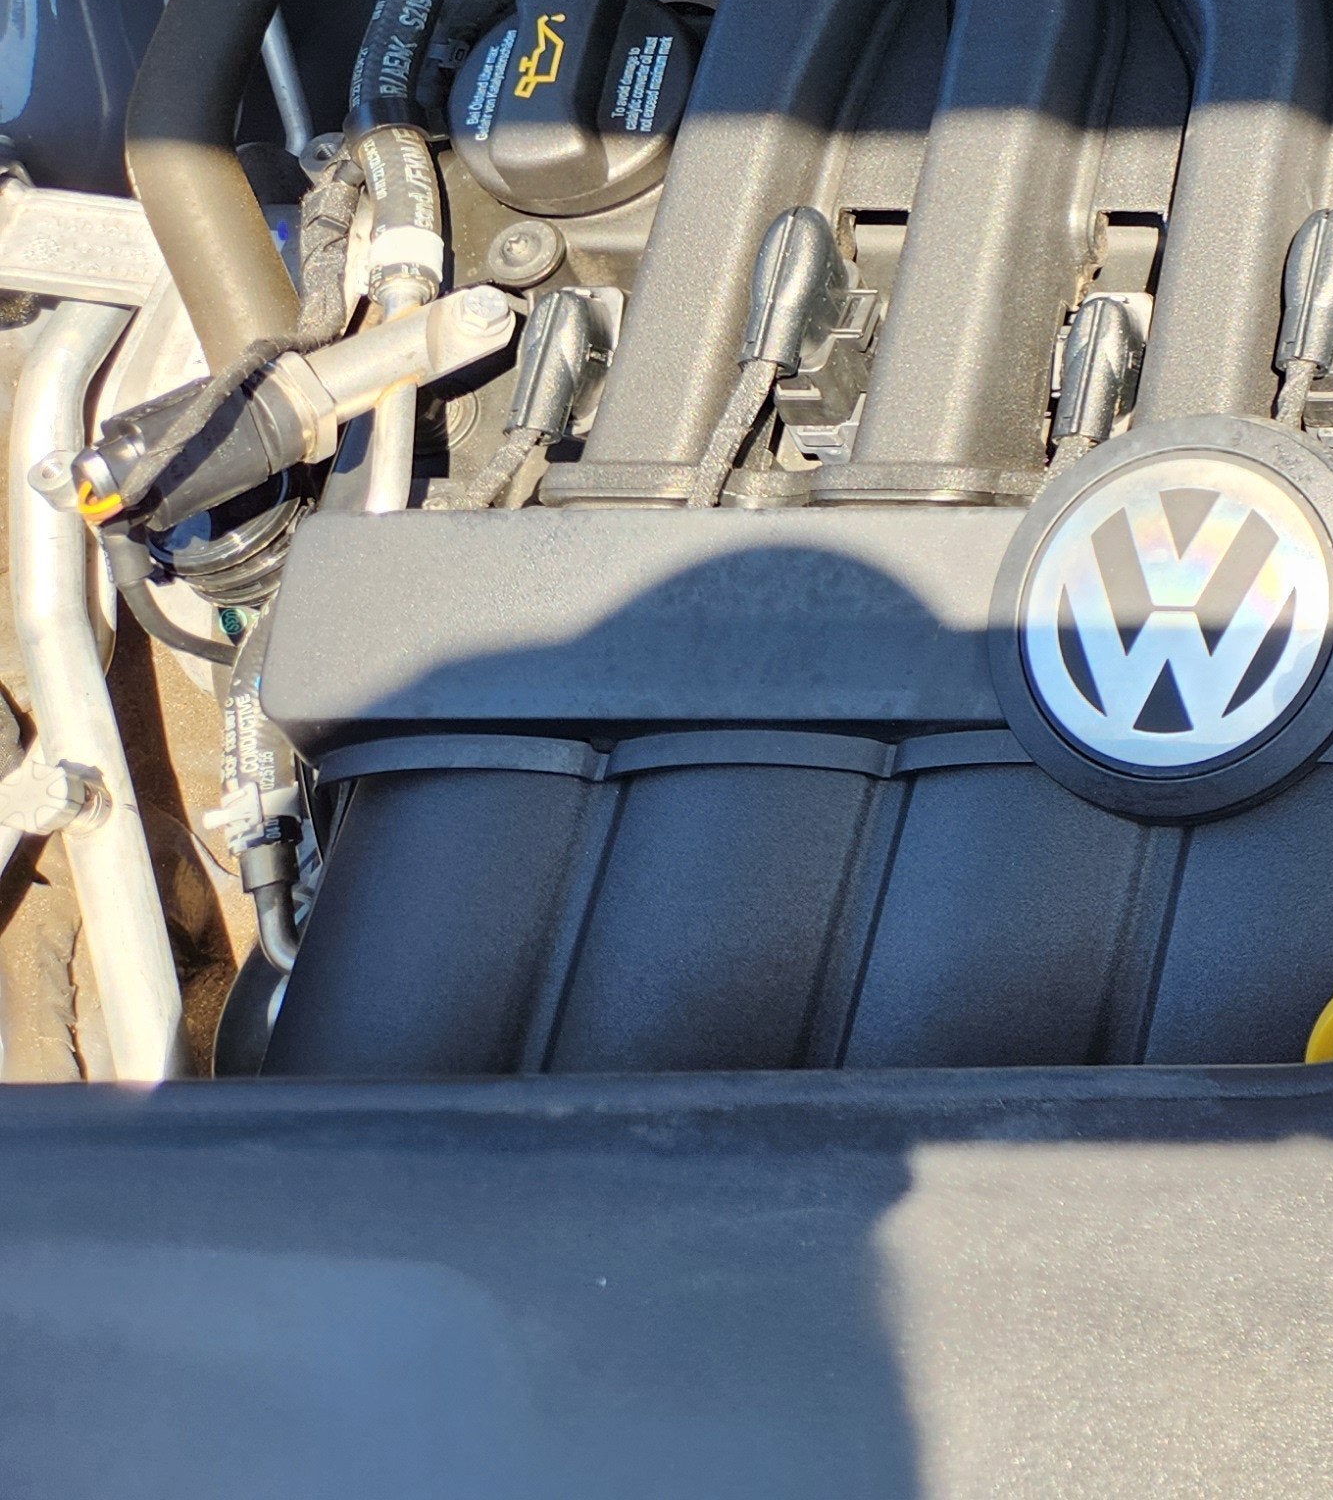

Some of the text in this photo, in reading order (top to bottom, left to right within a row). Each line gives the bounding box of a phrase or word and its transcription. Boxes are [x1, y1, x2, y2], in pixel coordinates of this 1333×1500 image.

[610, 46, 641, 119] To avoid damage to
[625, 36, 659, 131] catalytic converter oil must
[640, 35, 675, 132] not exceed maximum mark
[236, 693, 260, 775] CONDUCTIVE
